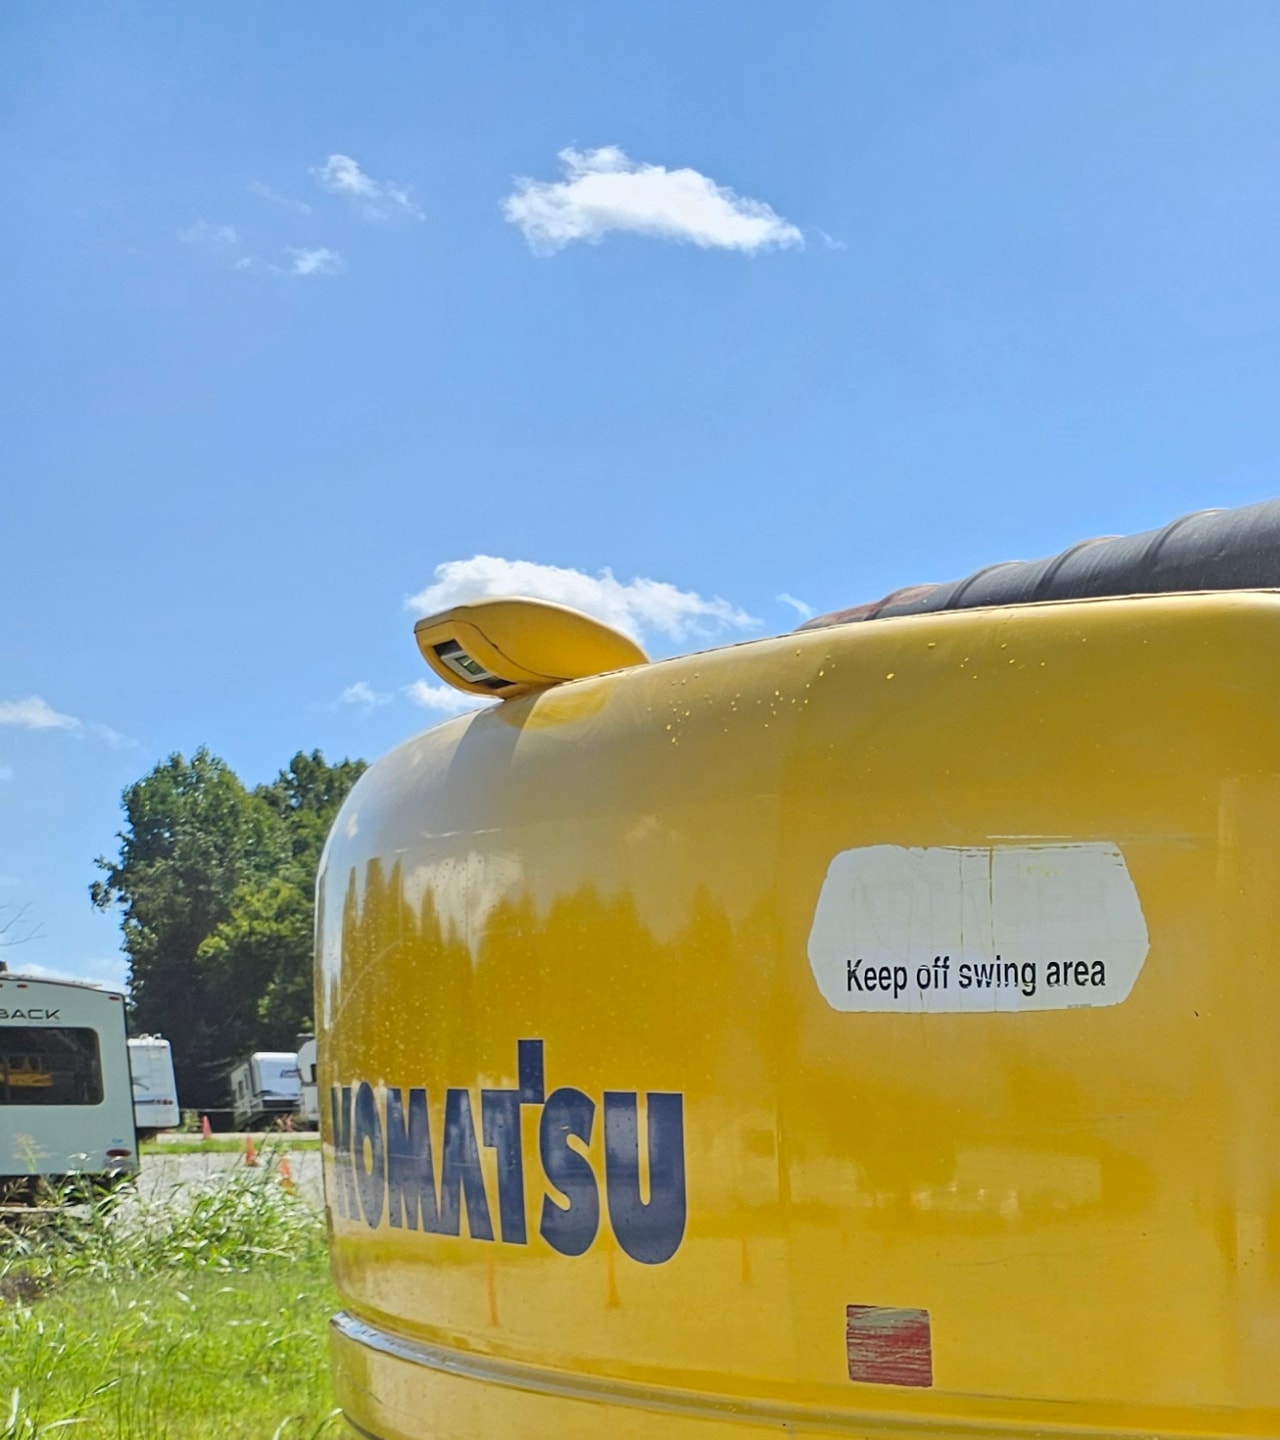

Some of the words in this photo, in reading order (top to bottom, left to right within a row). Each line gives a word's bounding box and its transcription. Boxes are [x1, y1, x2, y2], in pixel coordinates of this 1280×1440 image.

[846, 957, 908, 999] Keep
[916, 955, 950, 990] off
[957, 954, 1037, 997] swing
[1045, 959, 1106, 987] area
[330, 1039, 687, 1265] KOMATSU
